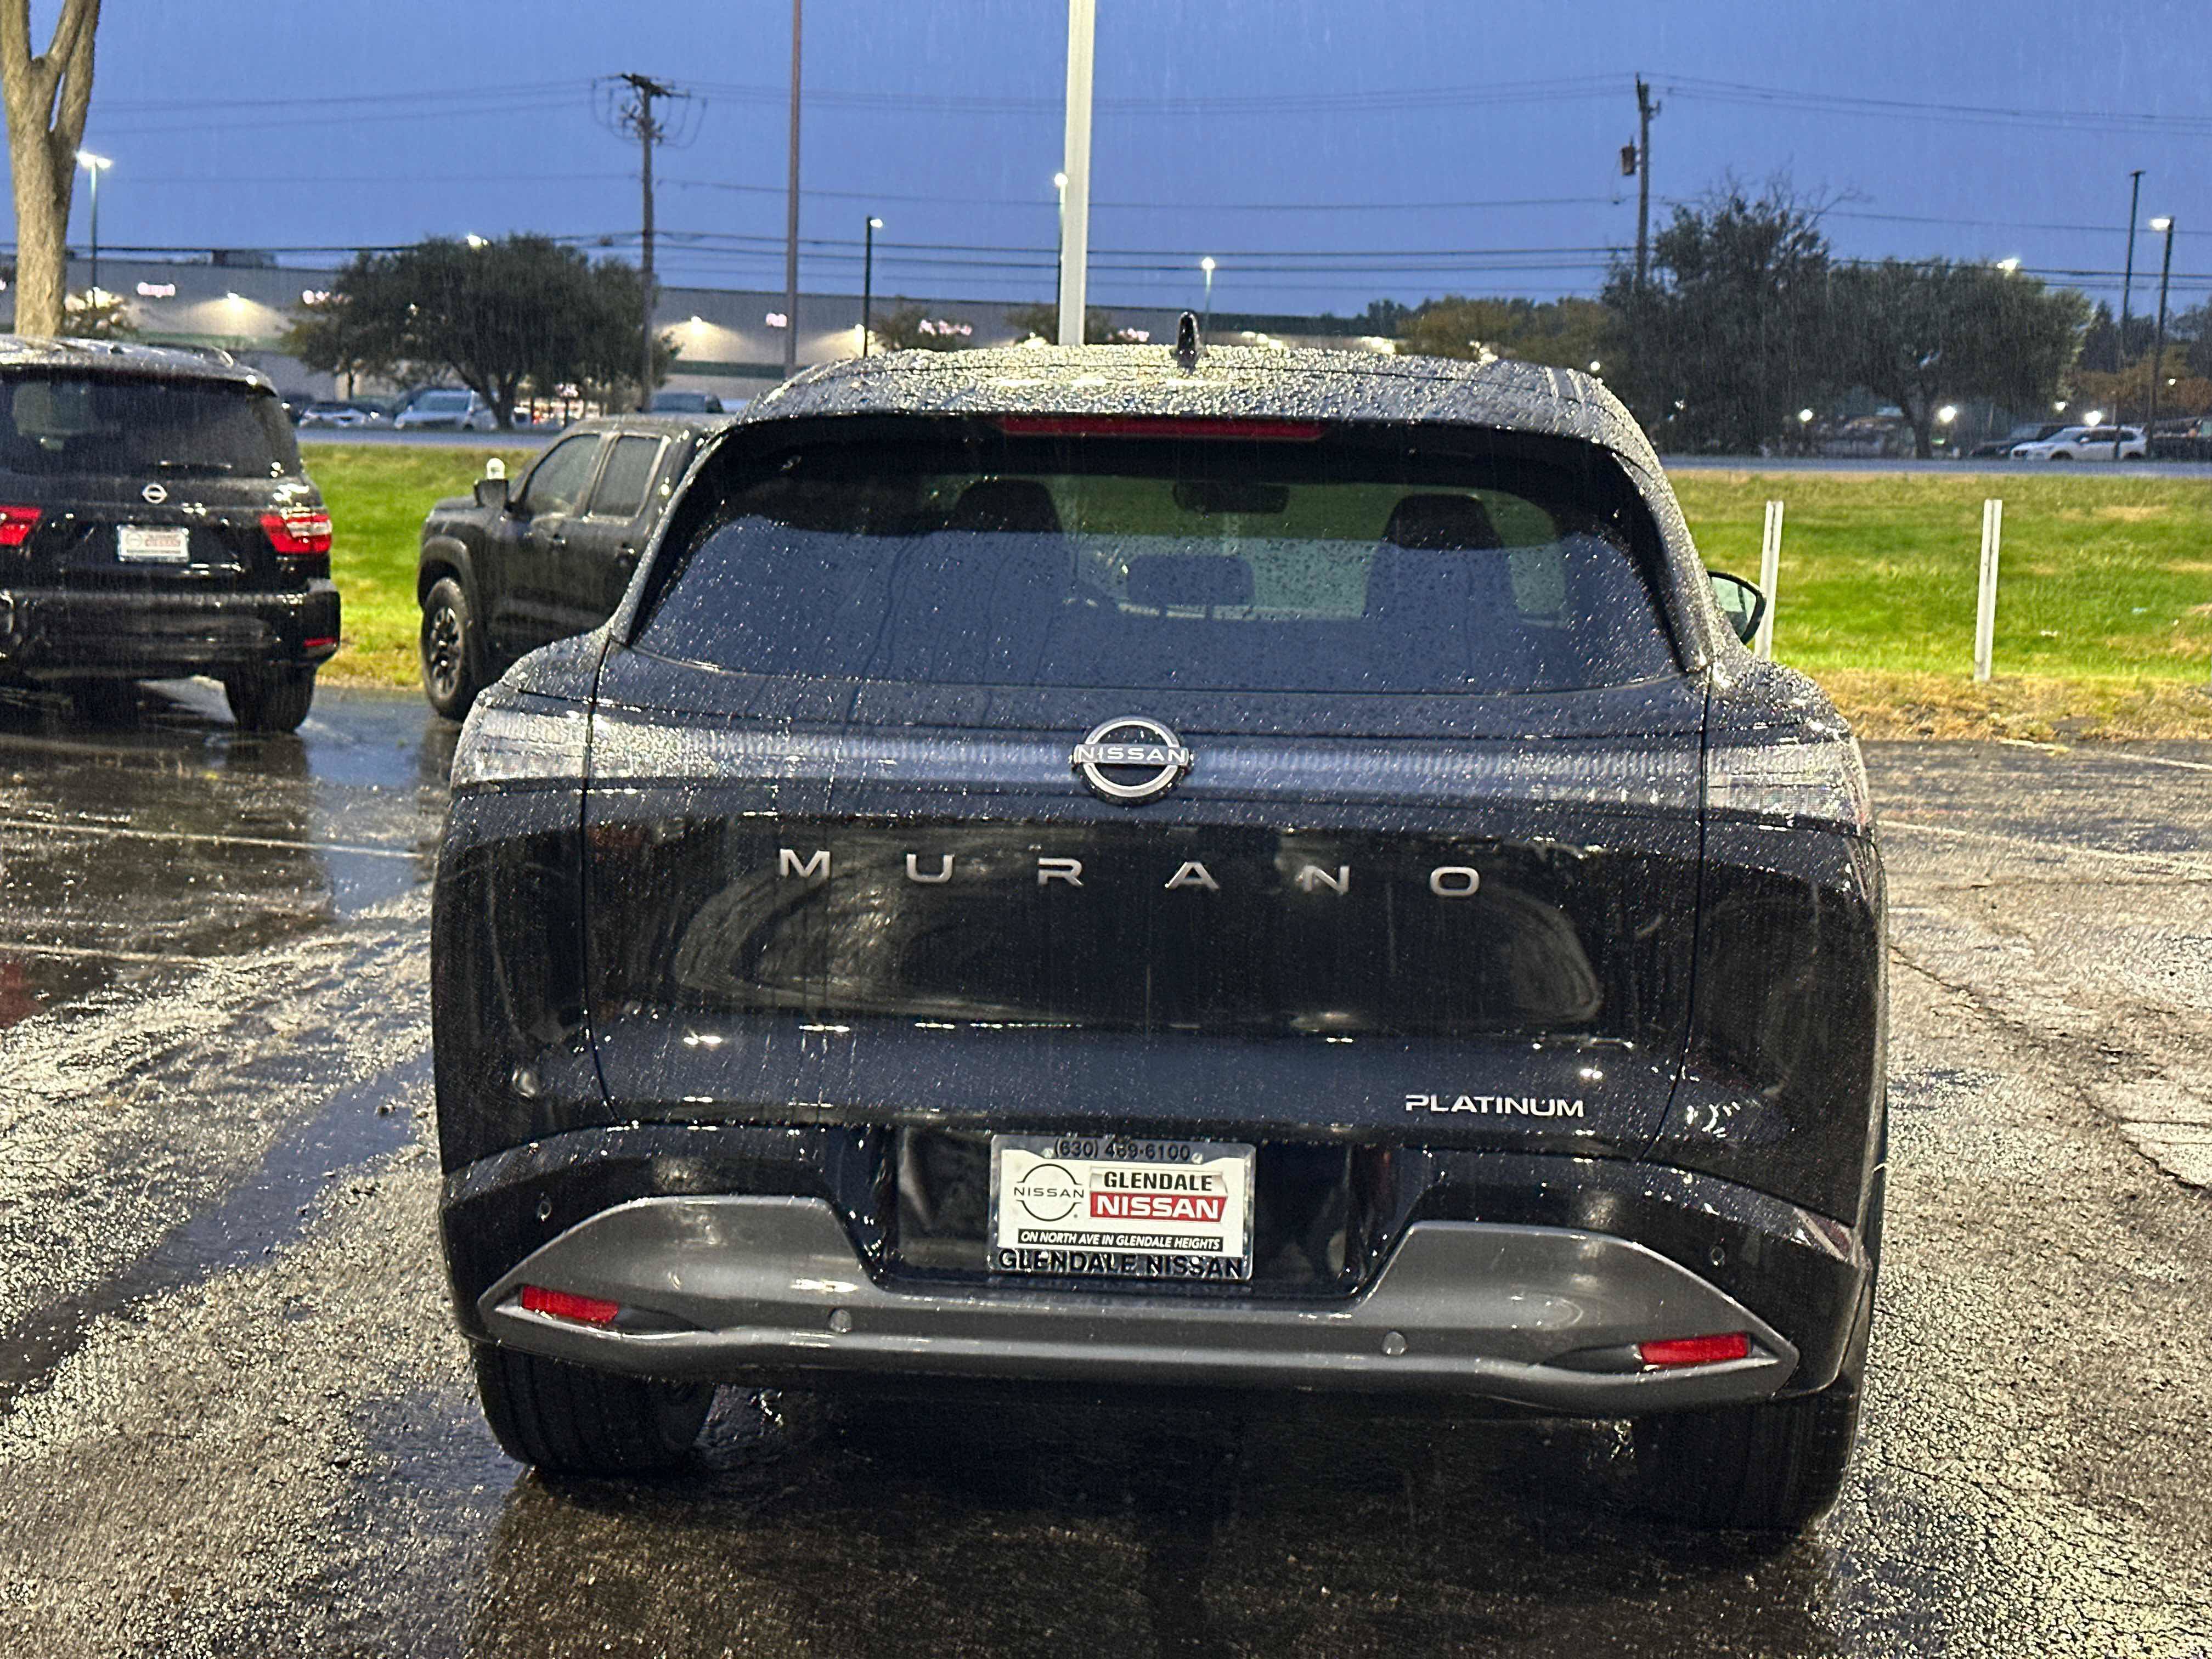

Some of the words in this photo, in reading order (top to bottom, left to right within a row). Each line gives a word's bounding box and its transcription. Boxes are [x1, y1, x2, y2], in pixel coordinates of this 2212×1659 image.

[1078, 747, 1186, 762] NISSAN
[780, 849, 1480, 896] MURANO
[1406, 1094, 1584, 1117] PLATINUM
[1054, 1138, 1097, 1159] (630)
[1104, 1171, 1212, 1192] GLENDALE
[1014, 1187, 1084, 1198] NISSAN
[1097, 1195, 1218, 1219] NISSAN
[1020, 1231, 1039, 1242] ON
[1040, 1232, 1077, 1244] NORTH
[1078, 1234, 1099, 1245] AVE
[1102, 1234, 1114, 1245] IN
[1116, 1235, 1172, 1248] GLENDALE
[1173, 1237, 1221, 1250] HEIGHTS
[999, 1248, 1137, 1273] GLENDALE
[1146, 1254, 1243, 1279] NISSAN
